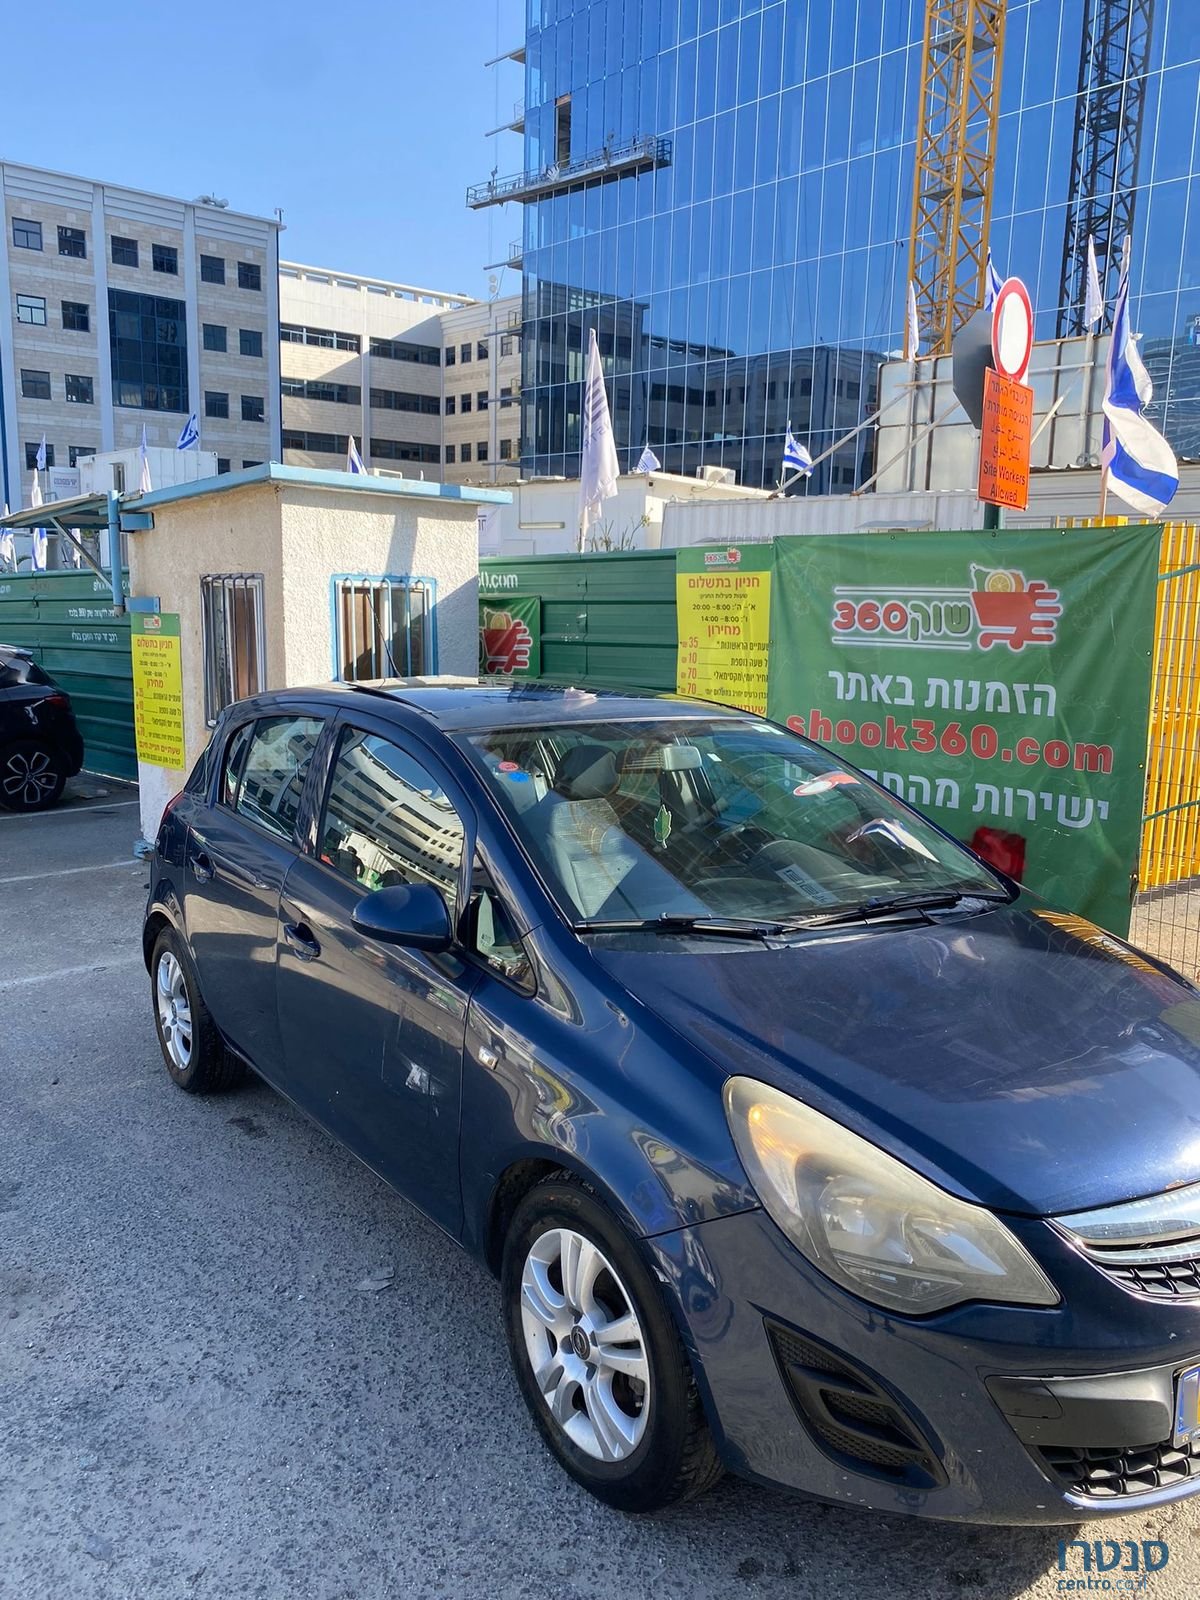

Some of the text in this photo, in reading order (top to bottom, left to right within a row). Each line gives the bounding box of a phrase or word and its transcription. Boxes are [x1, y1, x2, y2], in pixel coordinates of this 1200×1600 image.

[983, 460, 1026, 486] Site Workers
[990, 482, 1018, 503] Allowed
[688, 575, 760, 591] חניון בתשלום
[692, 603, 711, 611] 20:00
[700, 615, 719, 623] 14:00
[707, 624, 742, 638] מחירון
[159, 640, 173, 651] חניון
[688, 636, 699, 649] 35
[688, 651, 698, 664] 10
[748, 658, 763, 668] שעה
[687, 667, 697, 680] 70
[687, 682, 697, 695] 70
[828, 670, 1057, 716] הזמנות באתר
[786, 709, 1114, 774] shook360.com
[972, 783, 1110, 829] ישירות
